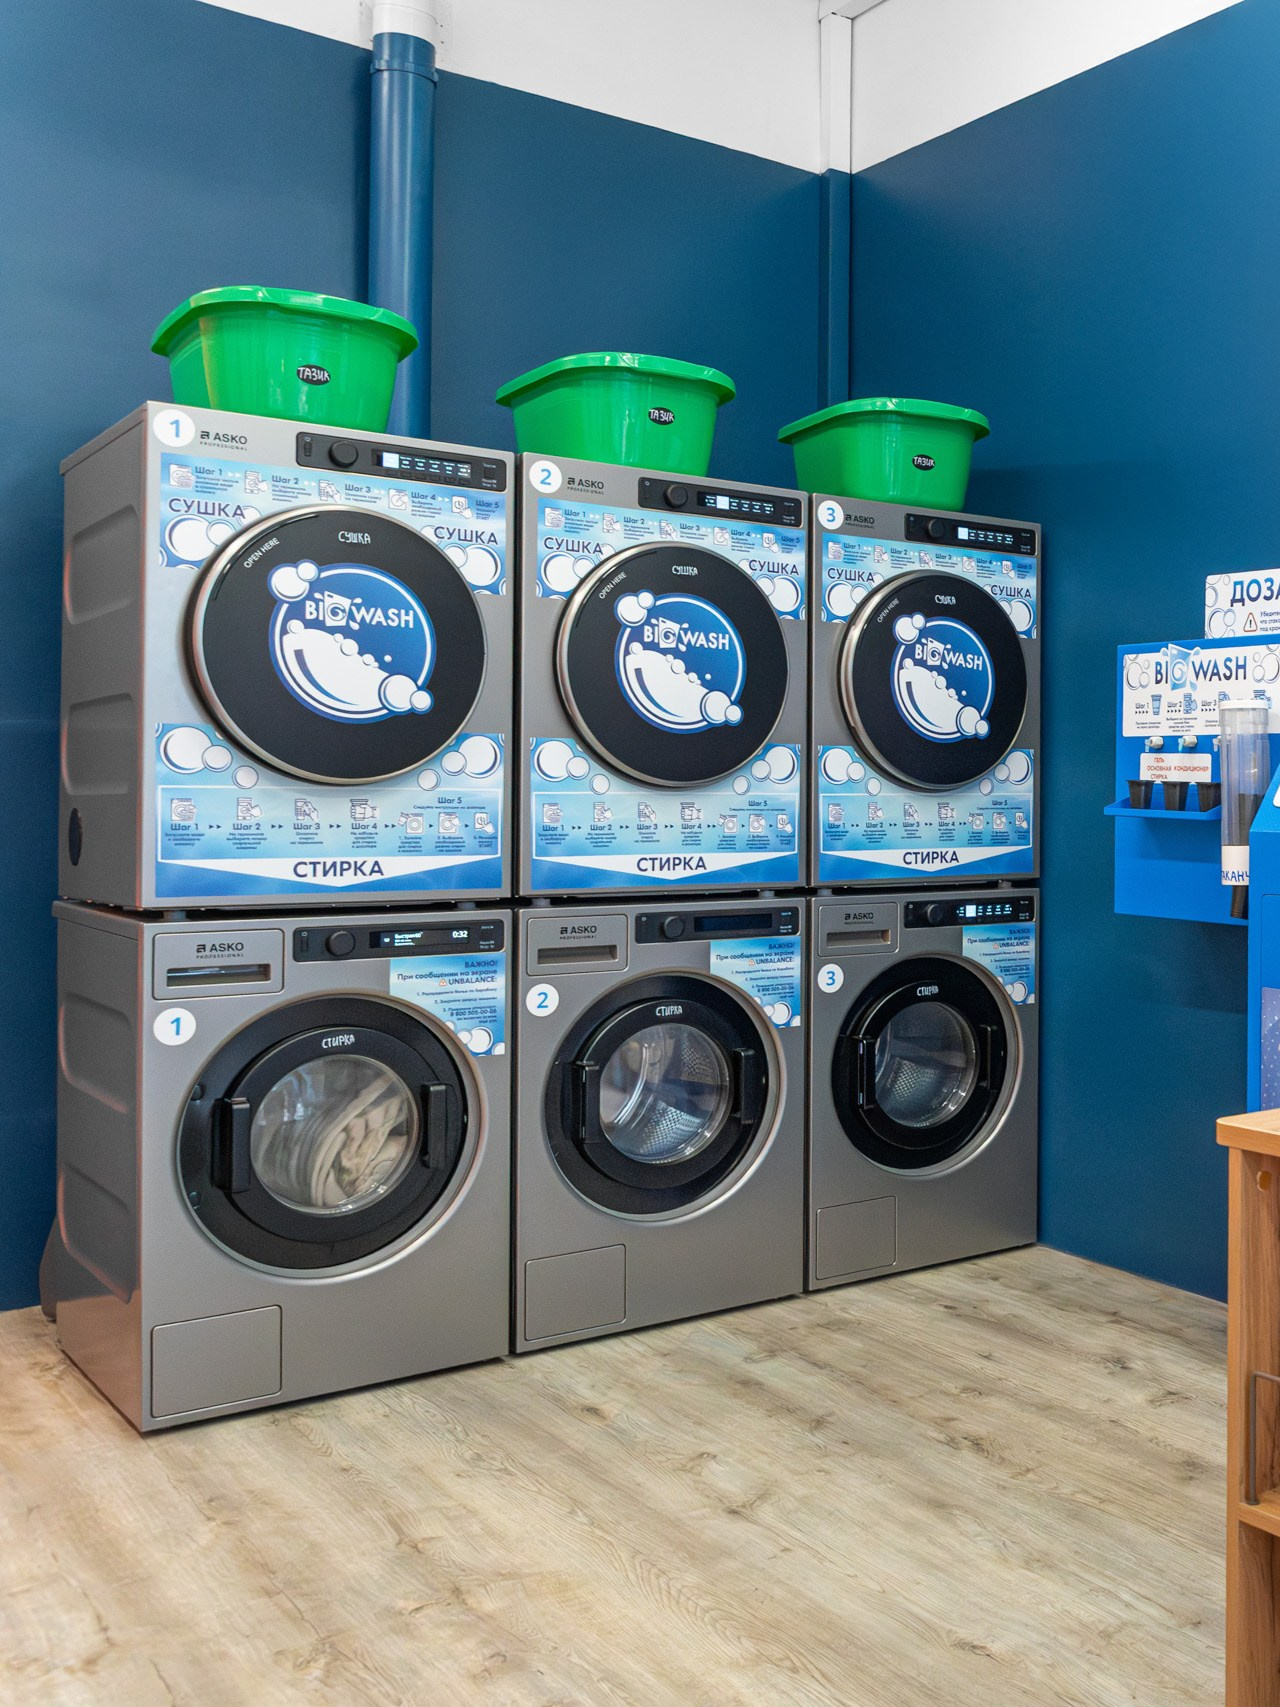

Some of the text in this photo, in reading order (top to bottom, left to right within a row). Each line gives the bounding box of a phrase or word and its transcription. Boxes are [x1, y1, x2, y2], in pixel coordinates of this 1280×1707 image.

[298, 367, 331, 381] ТАЗИК
[169, 419, 180, 438] 1
[213, 432, 248, 445] ASKO
[540, 468, 552, 486] 2
[577, 478, 604, 490] ASKO
[168, 498, 247, 520] СУШКА
[826, 507, 836, 522] 3
[853, 515, 875, 524] ASKO
[338, 530, 372, 545] СУШКА
[434, 526, 499, 546] СУШКА
[243, 537, 280, 569] OPEN HERE
[543, 537, 604, 555] СУШКА
[748, 560, 799, 576] СУШКА
[827, 568, 875, 583] СУШКА
[598, 571, 627, 600] OPEN HERE
[990, 585, 1032, 599] СУШКА
[636, 856, 707, 872] СТИРКА
[903, 851, 960, 865] СТИРКА
[293, 860, 384, 877] СТИРКА
[852, 912, 874, 920] ASKO
[570, 925, 597, 935] ASKO
[209, 942, 244, 953] ASKO
[826, 971, 836, 986] 3
[537, 991, 549, 1009] 2
[170, 1017, 182, 1036] 1
